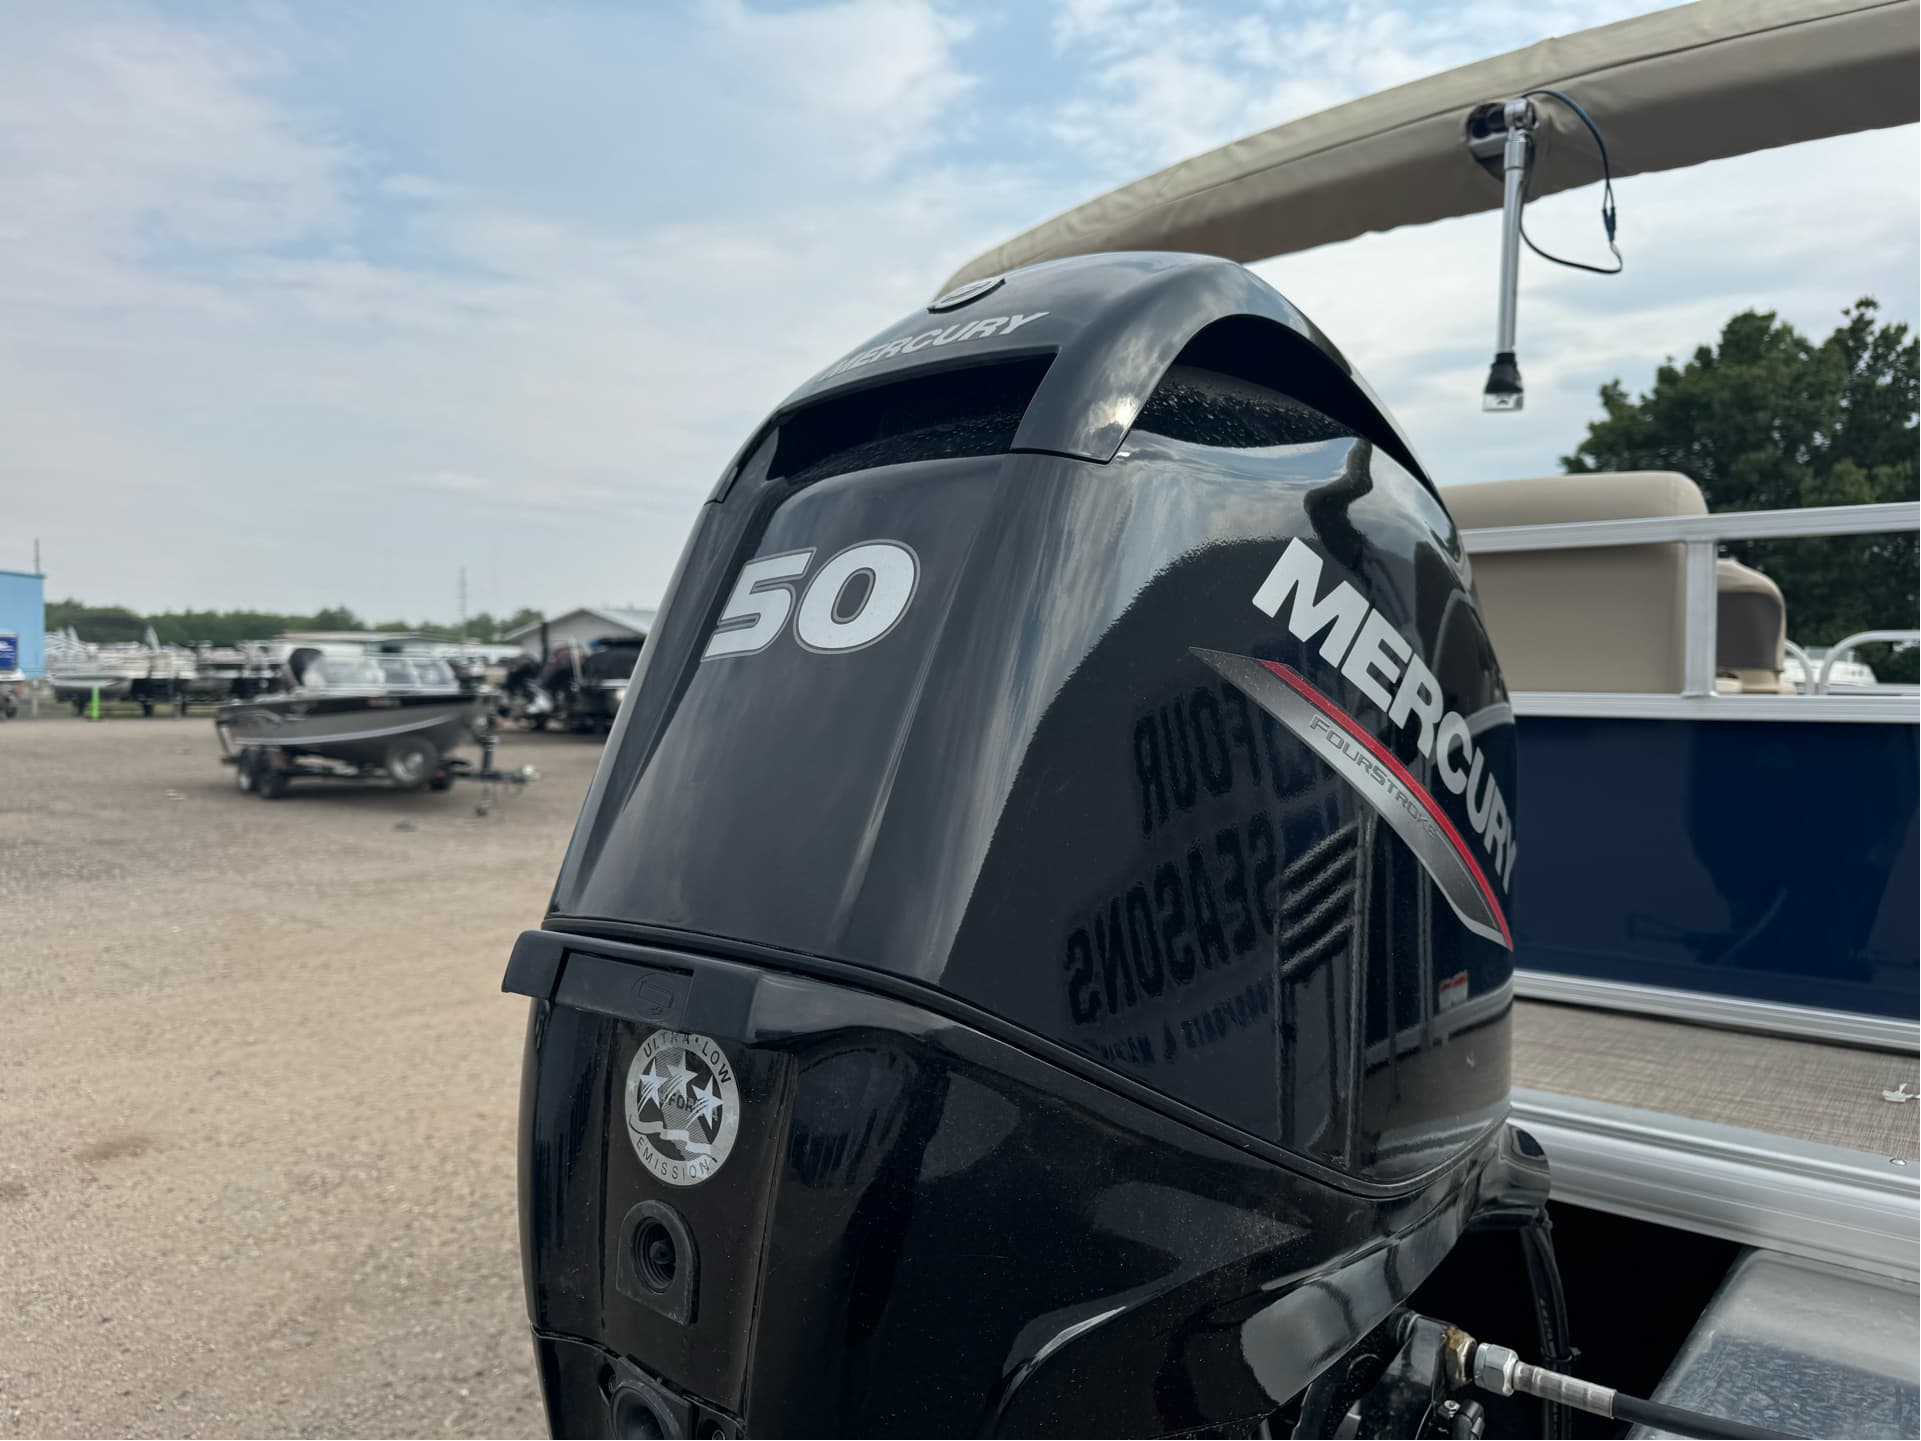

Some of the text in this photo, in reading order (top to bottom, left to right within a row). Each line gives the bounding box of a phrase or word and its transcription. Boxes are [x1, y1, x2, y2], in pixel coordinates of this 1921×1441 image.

[818, 311, 1051, 382] MERCURY
[701, 538, 921, 663] 50
[1252, 536, 1518, 894] MERCURY
[1309, 714, 1439, 841] FOURSTROKE
[643, 1031, 732, 1084] ULTRA LOW
